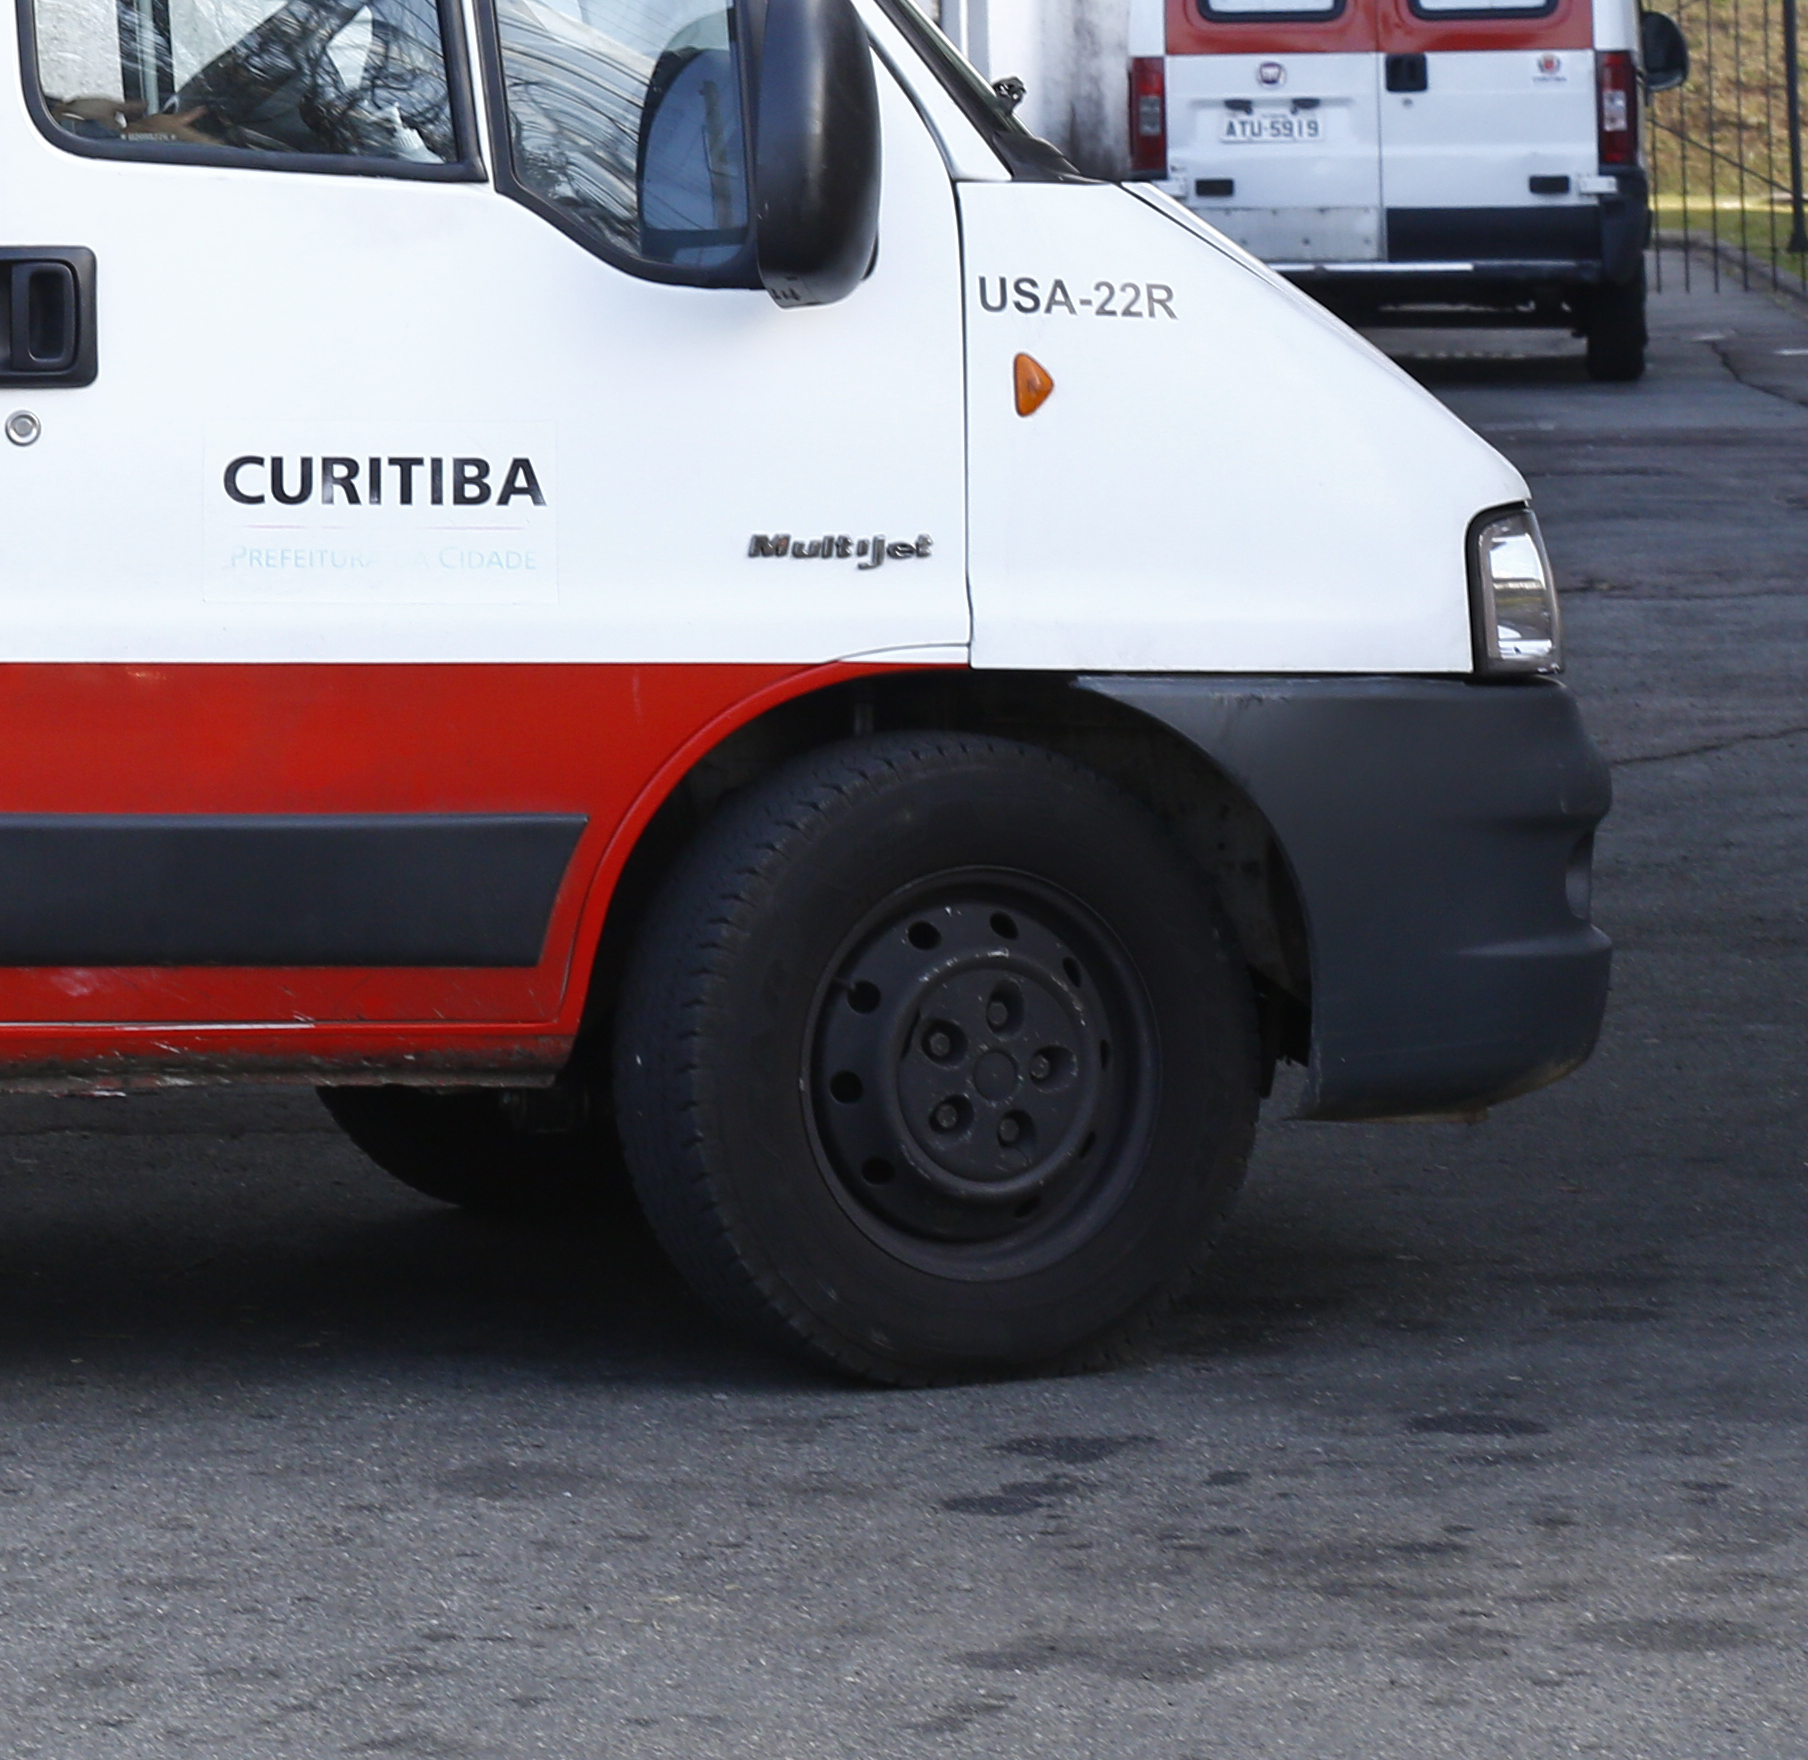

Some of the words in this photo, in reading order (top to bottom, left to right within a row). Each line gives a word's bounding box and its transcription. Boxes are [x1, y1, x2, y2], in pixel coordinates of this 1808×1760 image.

[978, 276, 1178, 320] USA-22R
[223, 455, 547, 506] CURITIBA
[747, 534, 933, 571] Multijet
